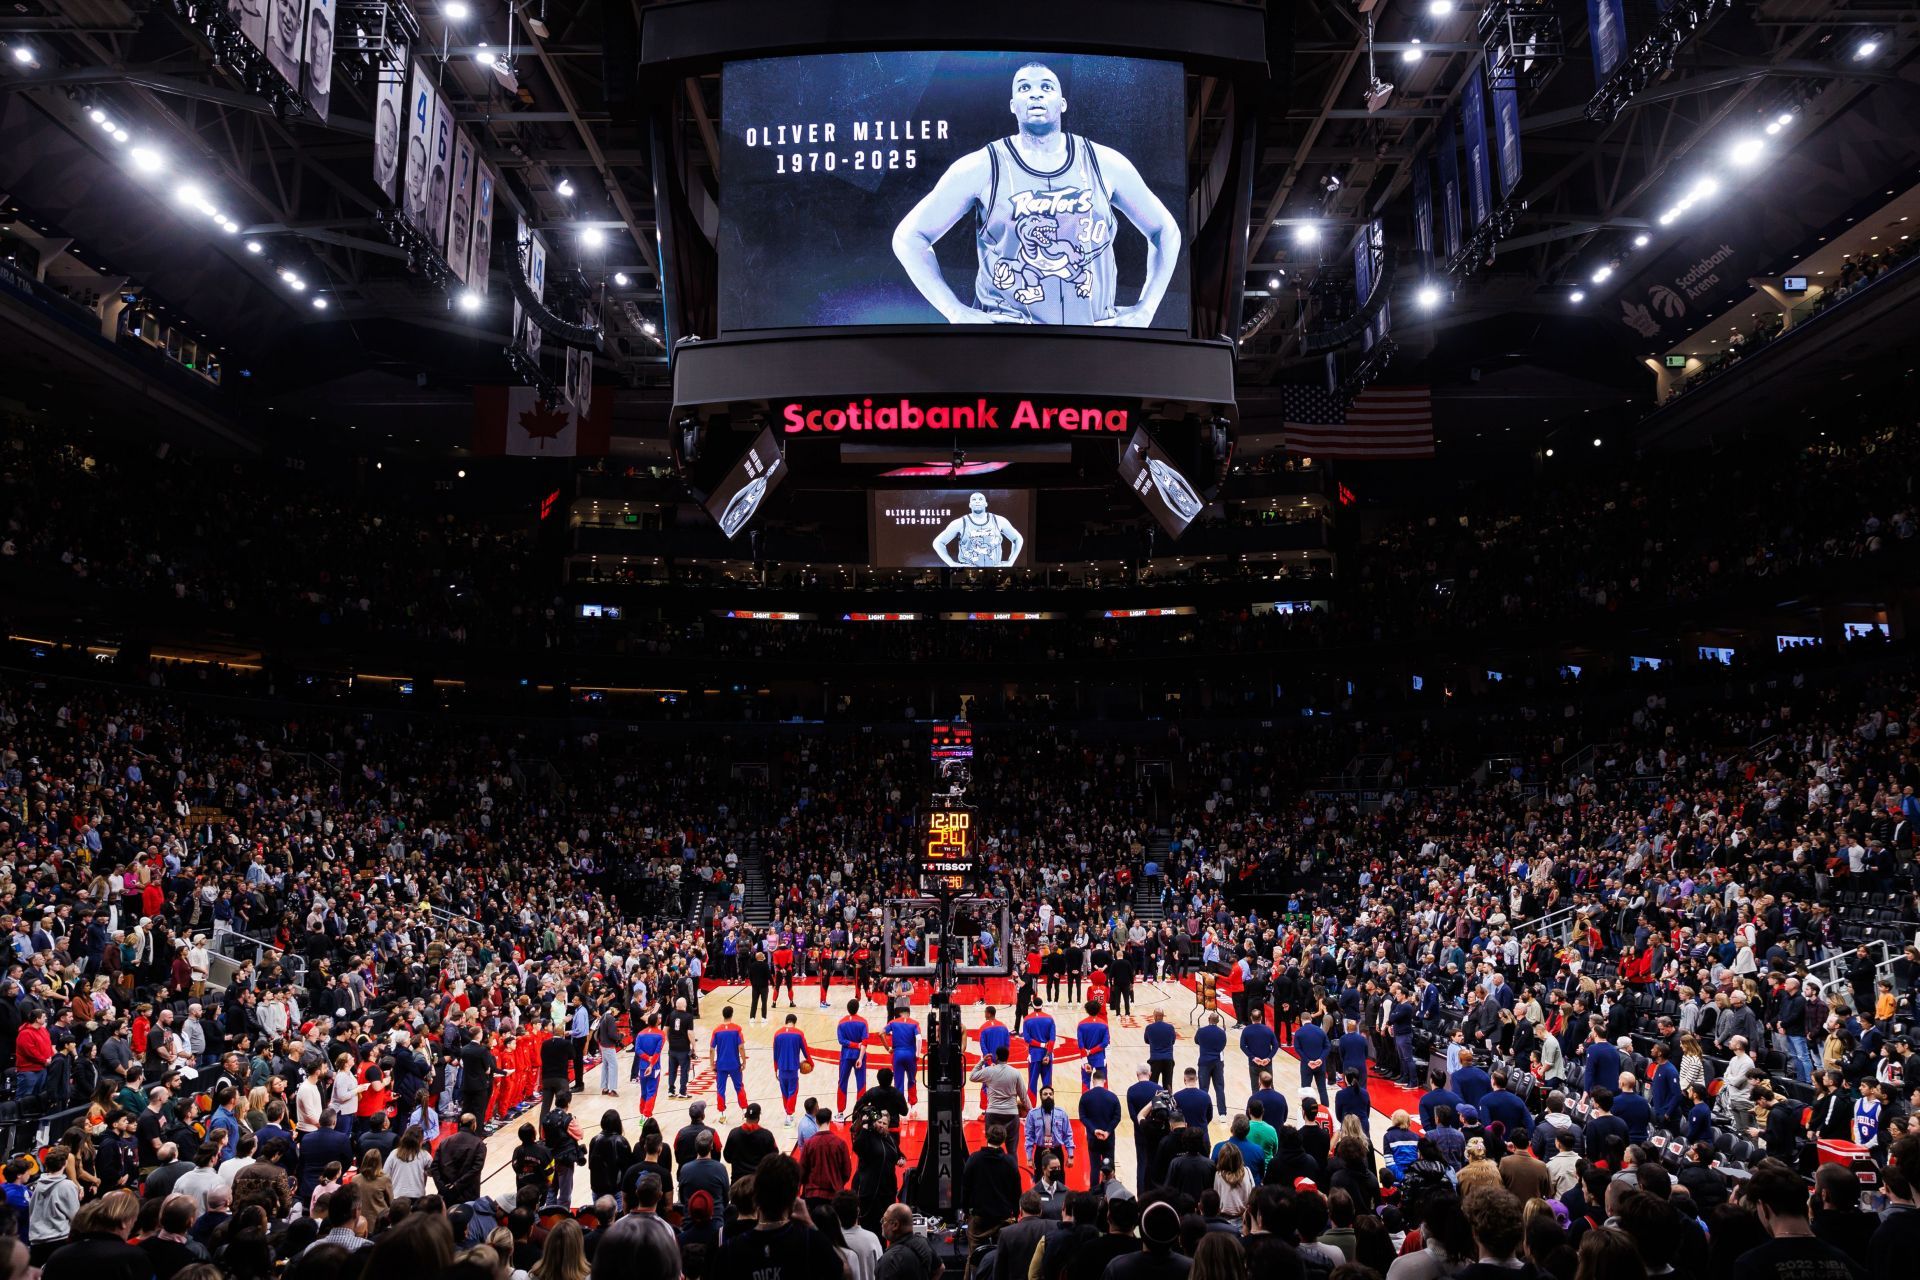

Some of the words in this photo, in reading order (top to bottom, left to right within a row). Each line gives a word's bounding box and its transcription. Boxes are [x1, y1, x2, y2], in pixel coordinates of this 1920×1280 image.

[417, 91, 427, 134] 4
[438, 120, 449, 162] 6
[746, 123, 836, 147] OLIVER
[853, 120, 949, 141] MILLER
[776, 149, 917, 174] 1970-2025
[1077, 218, 1107, 244] 30
[1675, 243, 1735, 290] Scotiabank
[1686, 272, 1721, 301] Arena
[783, 398, 999, 433] Scotiabank
[1011, 400, 1128, 432] Arena
[885, 509, 916, 517] OLIVER
[919, 508, 951, 516] MILLER
[895, 517, 941, 525] 1970-2025
[931, 813, 969, 829] 12:00
[928, 829, 966, 857] 24
[935, 863, 973, 871] TISSOT
[938, 1119, 951, 1179] NBA
[1775, 1259, 1815, 1272] 2022
